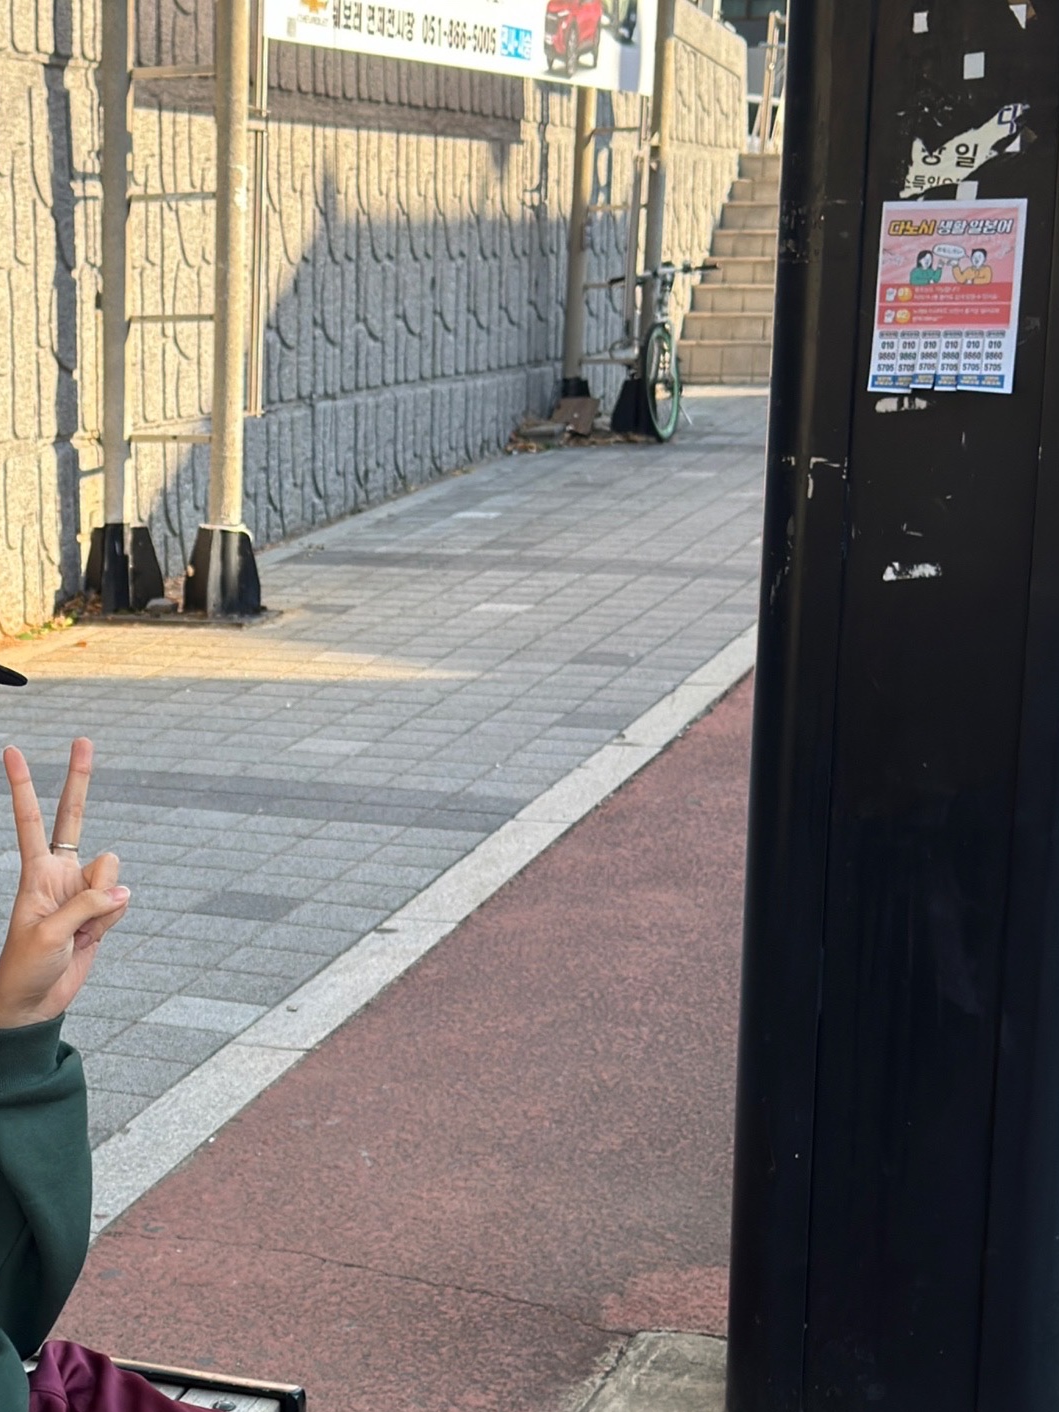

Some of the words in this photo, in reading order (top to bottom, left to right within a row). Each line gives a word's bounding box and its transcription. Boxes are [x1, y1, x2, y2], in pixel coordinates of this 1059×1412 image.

[888, 219, 936, 236] 다노시
[937, 219, 967, 235] 생활
[968, 218, 1013, 235] 일본어
[881, 341, 894, 350] 010
[903, 341, 915, 350] 010
[924, 341, 936, 350] 010
[945, 341, 958, 350] 010
[967, 341, 980, 350] 010
[988, 341, 1001, 350] 010
[877, 363, 894, 372] 5705
[898, 363, 915, 372] 5705
[919, 362, 936, 371] 5705
[941, 363, 958, 372] 5705
[963, 363, 980, 372] 5705
[984, 363, 1001, 372] 5705
